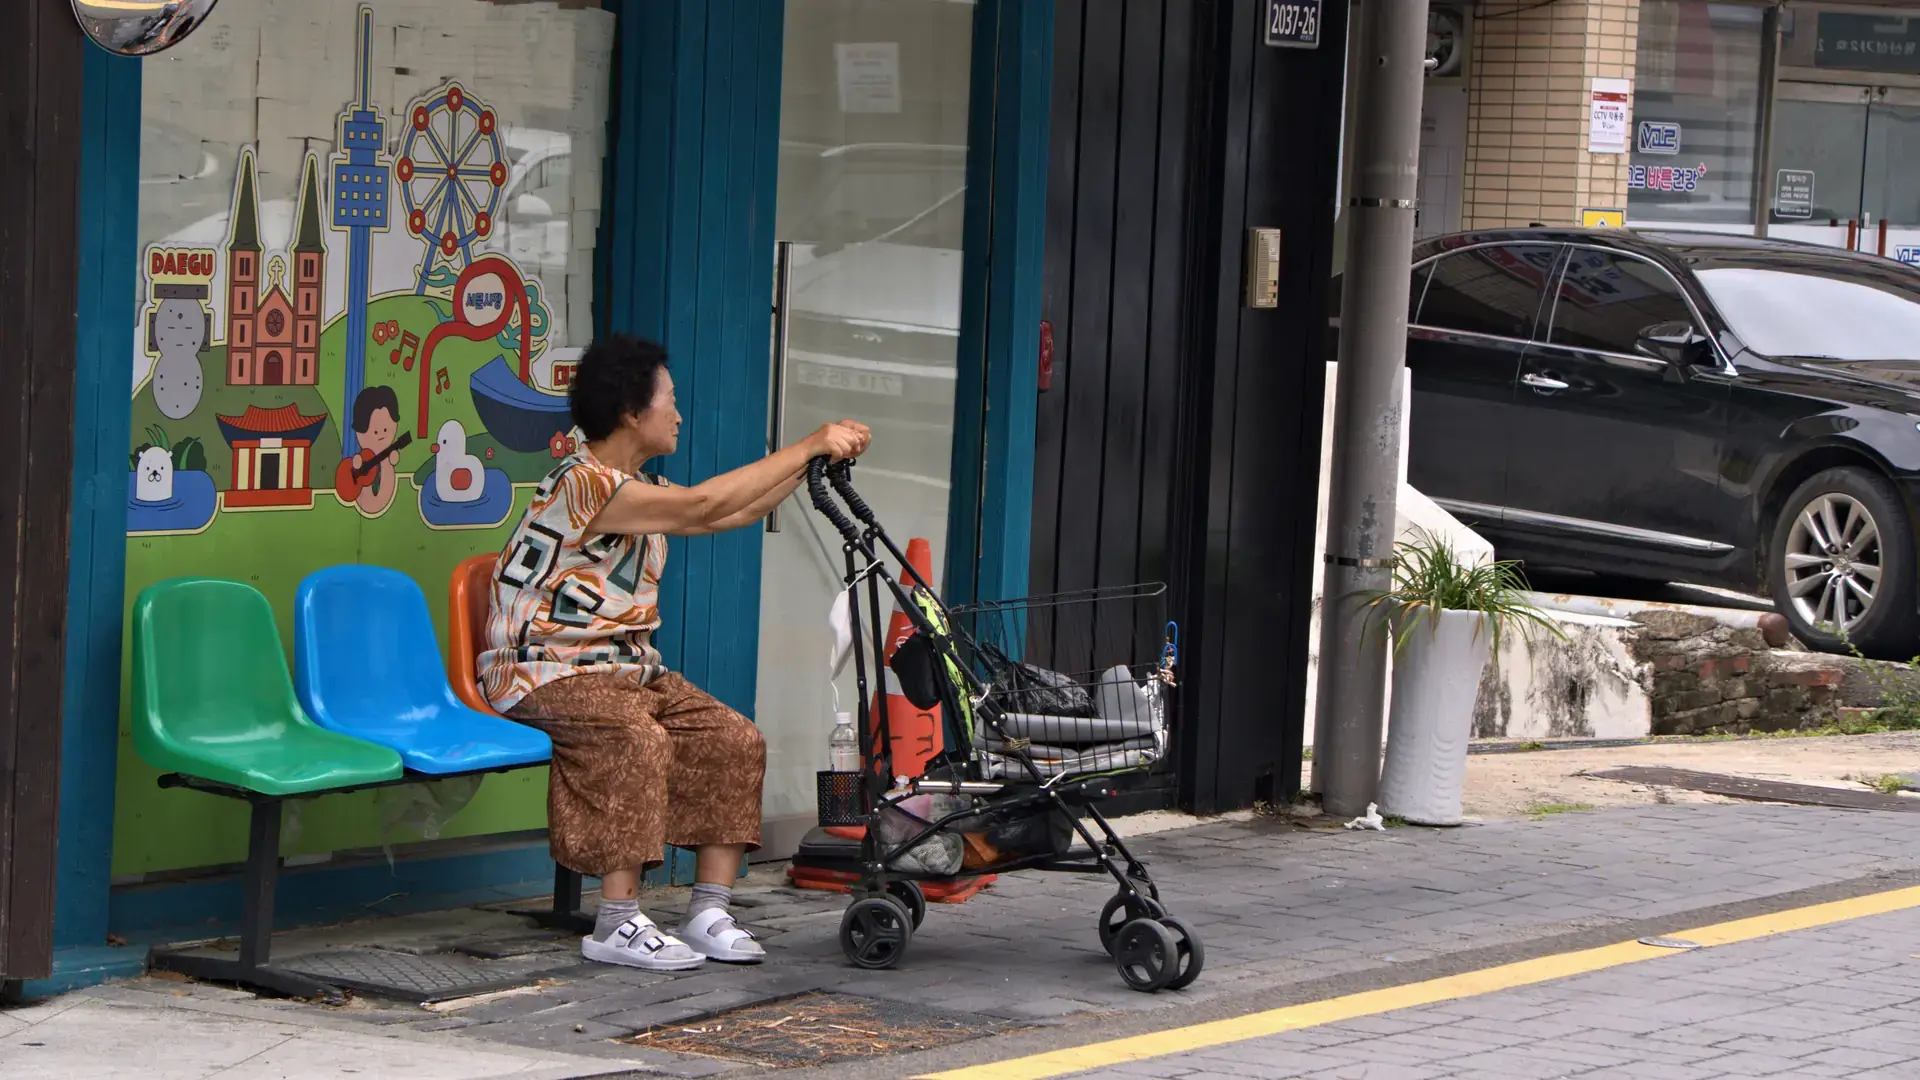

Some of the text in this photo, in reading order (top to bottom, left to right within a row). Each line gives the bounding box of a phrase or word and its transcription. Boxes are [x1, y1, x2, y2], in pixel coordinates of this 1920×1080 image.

[1272, 4, 1316, 35] 2037-26
[1594, 111, 1607, 120] CCTV
[152, 252, 213, 276] DAEGU
[554, 365, 577, 386] 대
